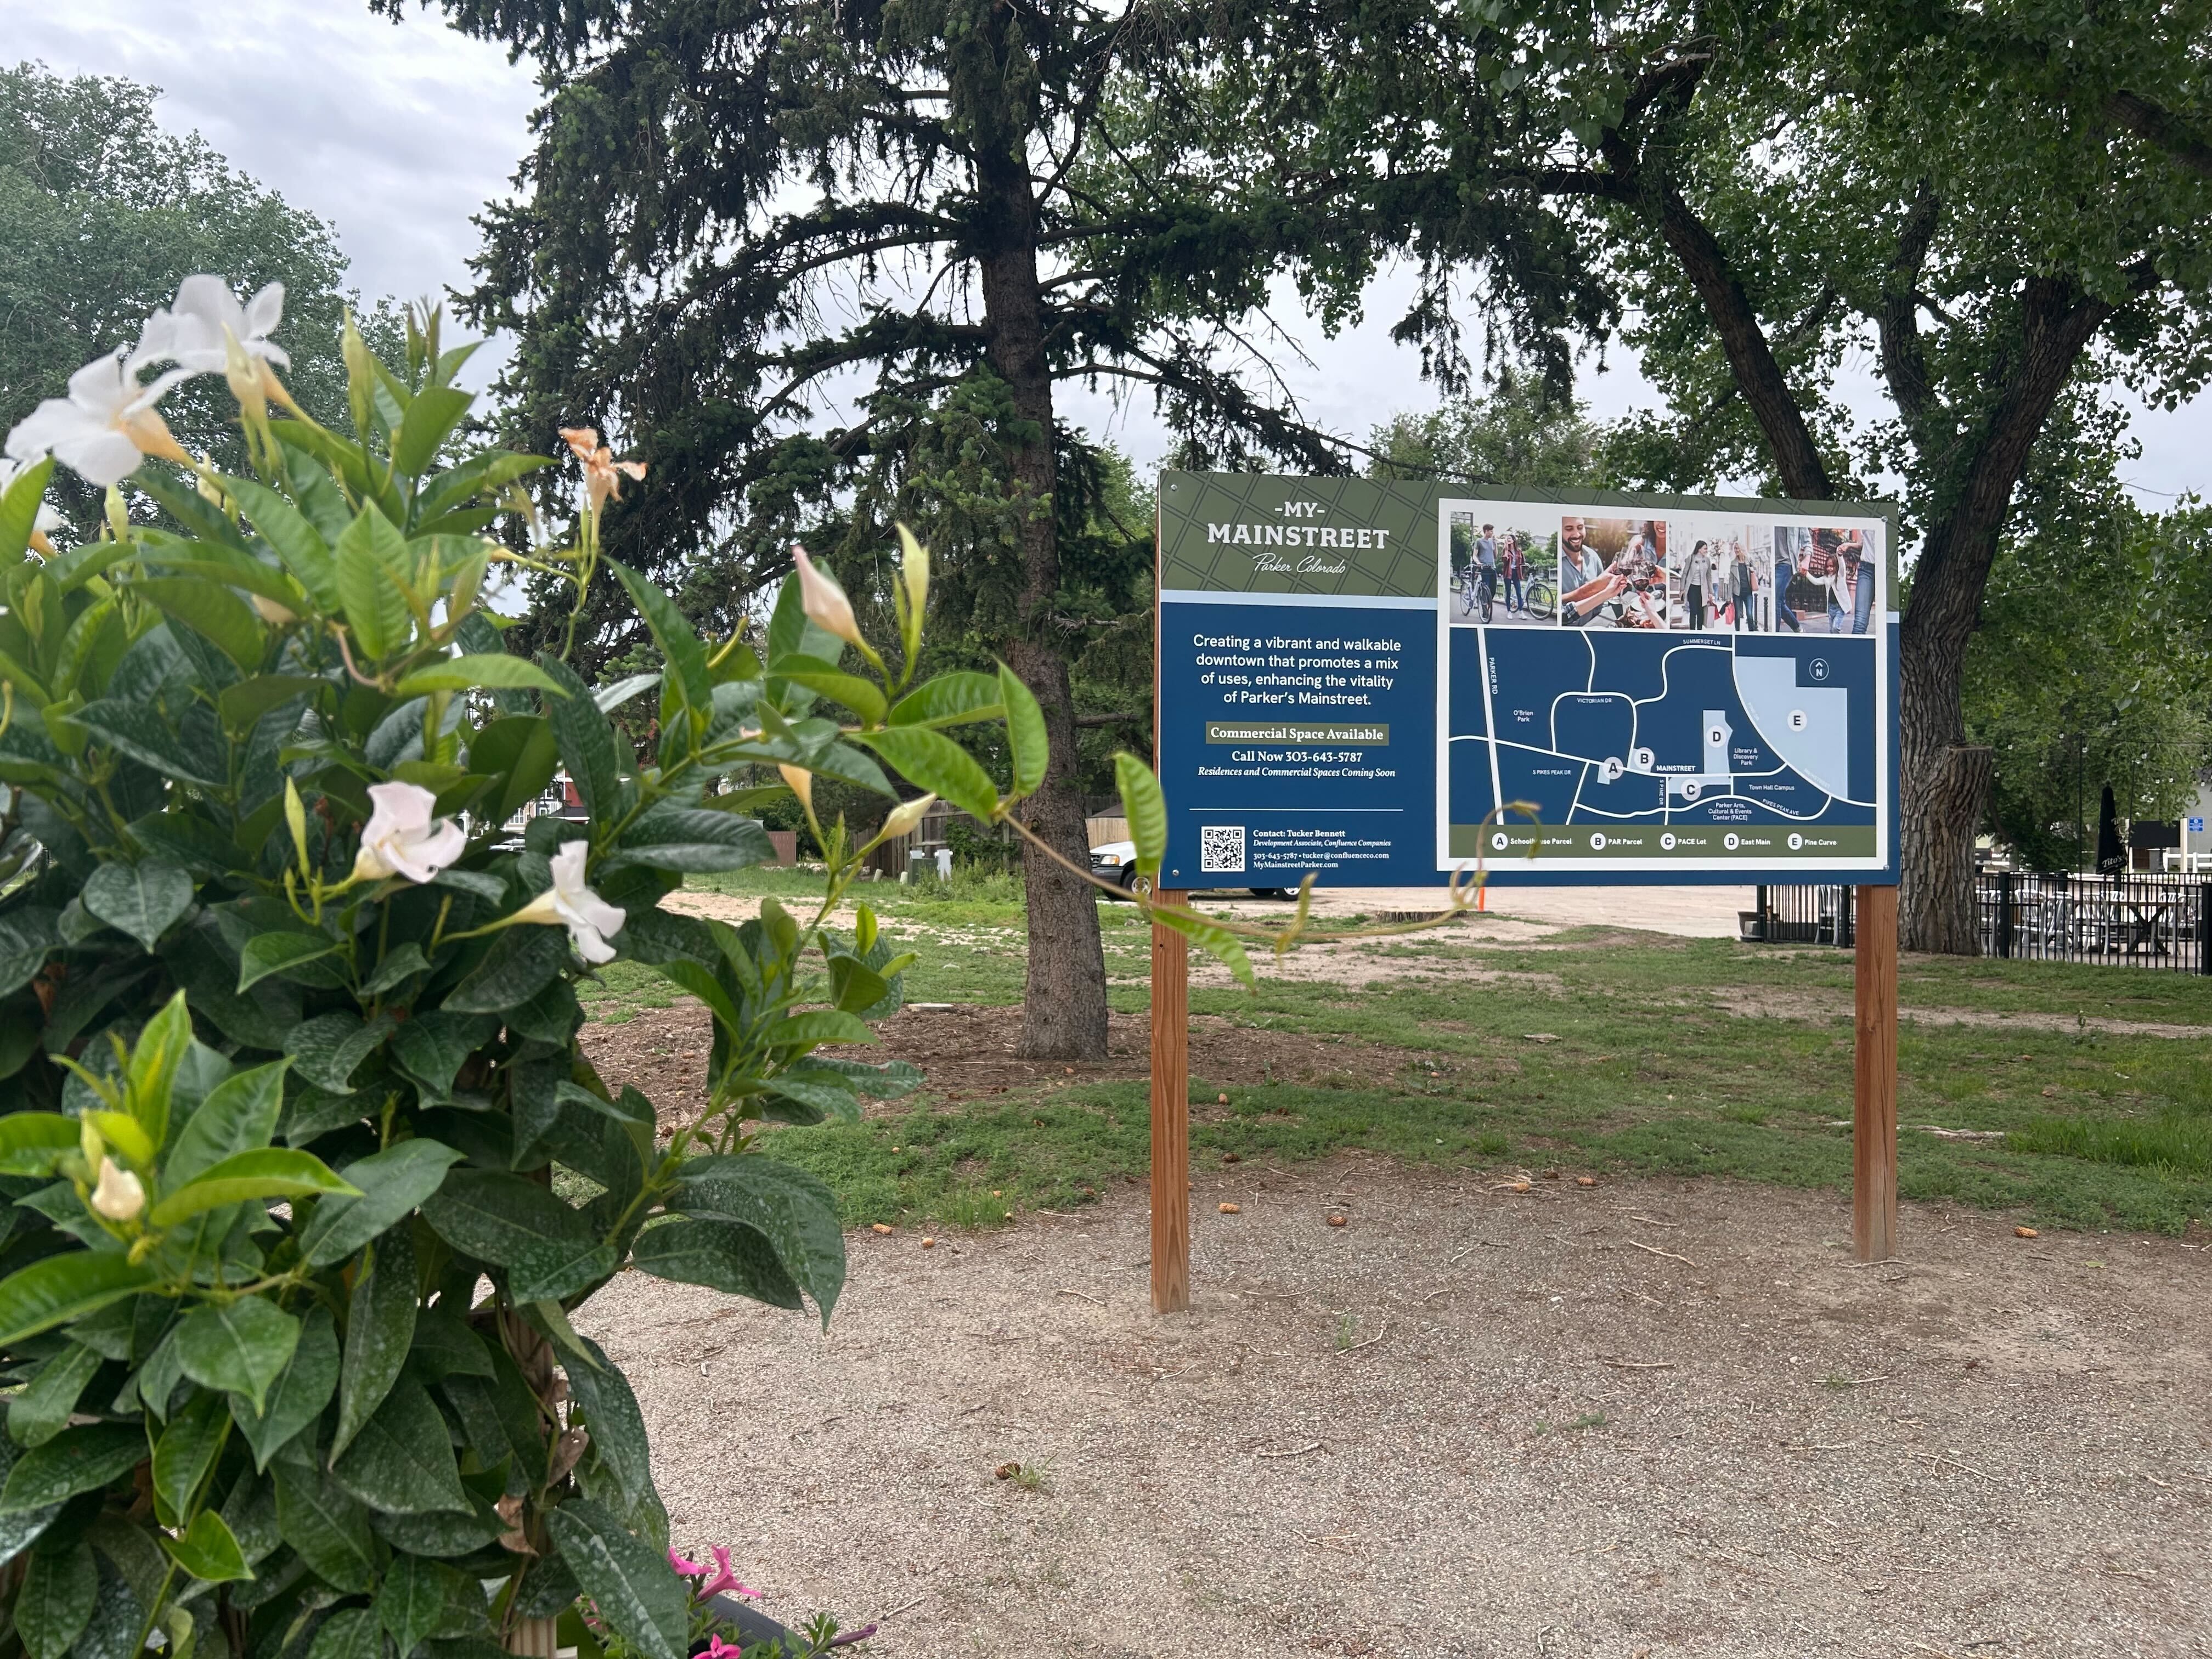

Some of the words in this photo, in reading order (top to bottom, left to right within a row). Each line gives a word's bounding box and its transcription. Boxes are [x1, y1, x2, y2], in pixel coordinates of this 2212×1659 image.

[1275, 501, 1325, 517] -MY-
[1208, 523, 1389, 549] MAINSTREET
[1252, 553, 1292, 571] Parker
[1297, 556, 1345, 573] Colorado
[1194, 634, 1250, 651] Creating
[1254, 639, 1261, 648] a
[1266, 636, 1312, 649] vibrant
[1316, 638, 1339, 650] and
[1344, 639, 1401, 651] walkable
[1197, 653, 1264, 666] downtown
[1268, 655, 1295, 667] that
[1299, 657, 1360, 670] promotes
[1364, 660, 1372, 668] a
[1376, 661, 1398, 669] mix
[1489, 657, 1497, 683] PARKER
[1201, 672, 1215, 684] of
[1219, 675, 1251, 687] uses,
[1256, 673, 1322, 689] enhancing
[1325, 674, 1346, 686] the
[1350, 675, 1393, 690] vitality
[1492, 684, 1498, 695] RD
[1224, 691, 1237, 703] of
[1242, 691, 1294, 703] Parker's
[1299, 692, 1371, 705] Mainstreet.
[1794, 715, 1801, 725] E
[1211, 727, 1286, 738] Commercial
[1290, 729, 1324, 742] Space
[1327, 729, 1383, 740] Available
[1713, 732, 1720, 742] D
[1232, 751, 1255, 761] Call
[1257, 751, 1283, 761] Now
[1286, 752, 1362, 762] 303-643-5787
[1641, 753, 1649, 764] B
[1198, 767, 1242, 775] Residences
[1244, 768, 1260, 776] and
[1262, 768, 1312, 776] Commercial
[1313, 768, 1340, 778] Spaces
[1342, 768, 1374, 779] Coming
[1375, 768, 1395, 776] Soon
[1609, 763, 1618, 773] A
[1687, 785, 1695, 795] C
[1762, 798, 1776, 809] PIKES
[1776, 804, 1790, 813] PEAK
[1254, 839, 1293, 848] Development
[1324, 839, 1357, 848] Confluence
[1254, 861, 1338, 870] MyMainstreetParker.com
[2102, 855, 2123, 868] Tito's
